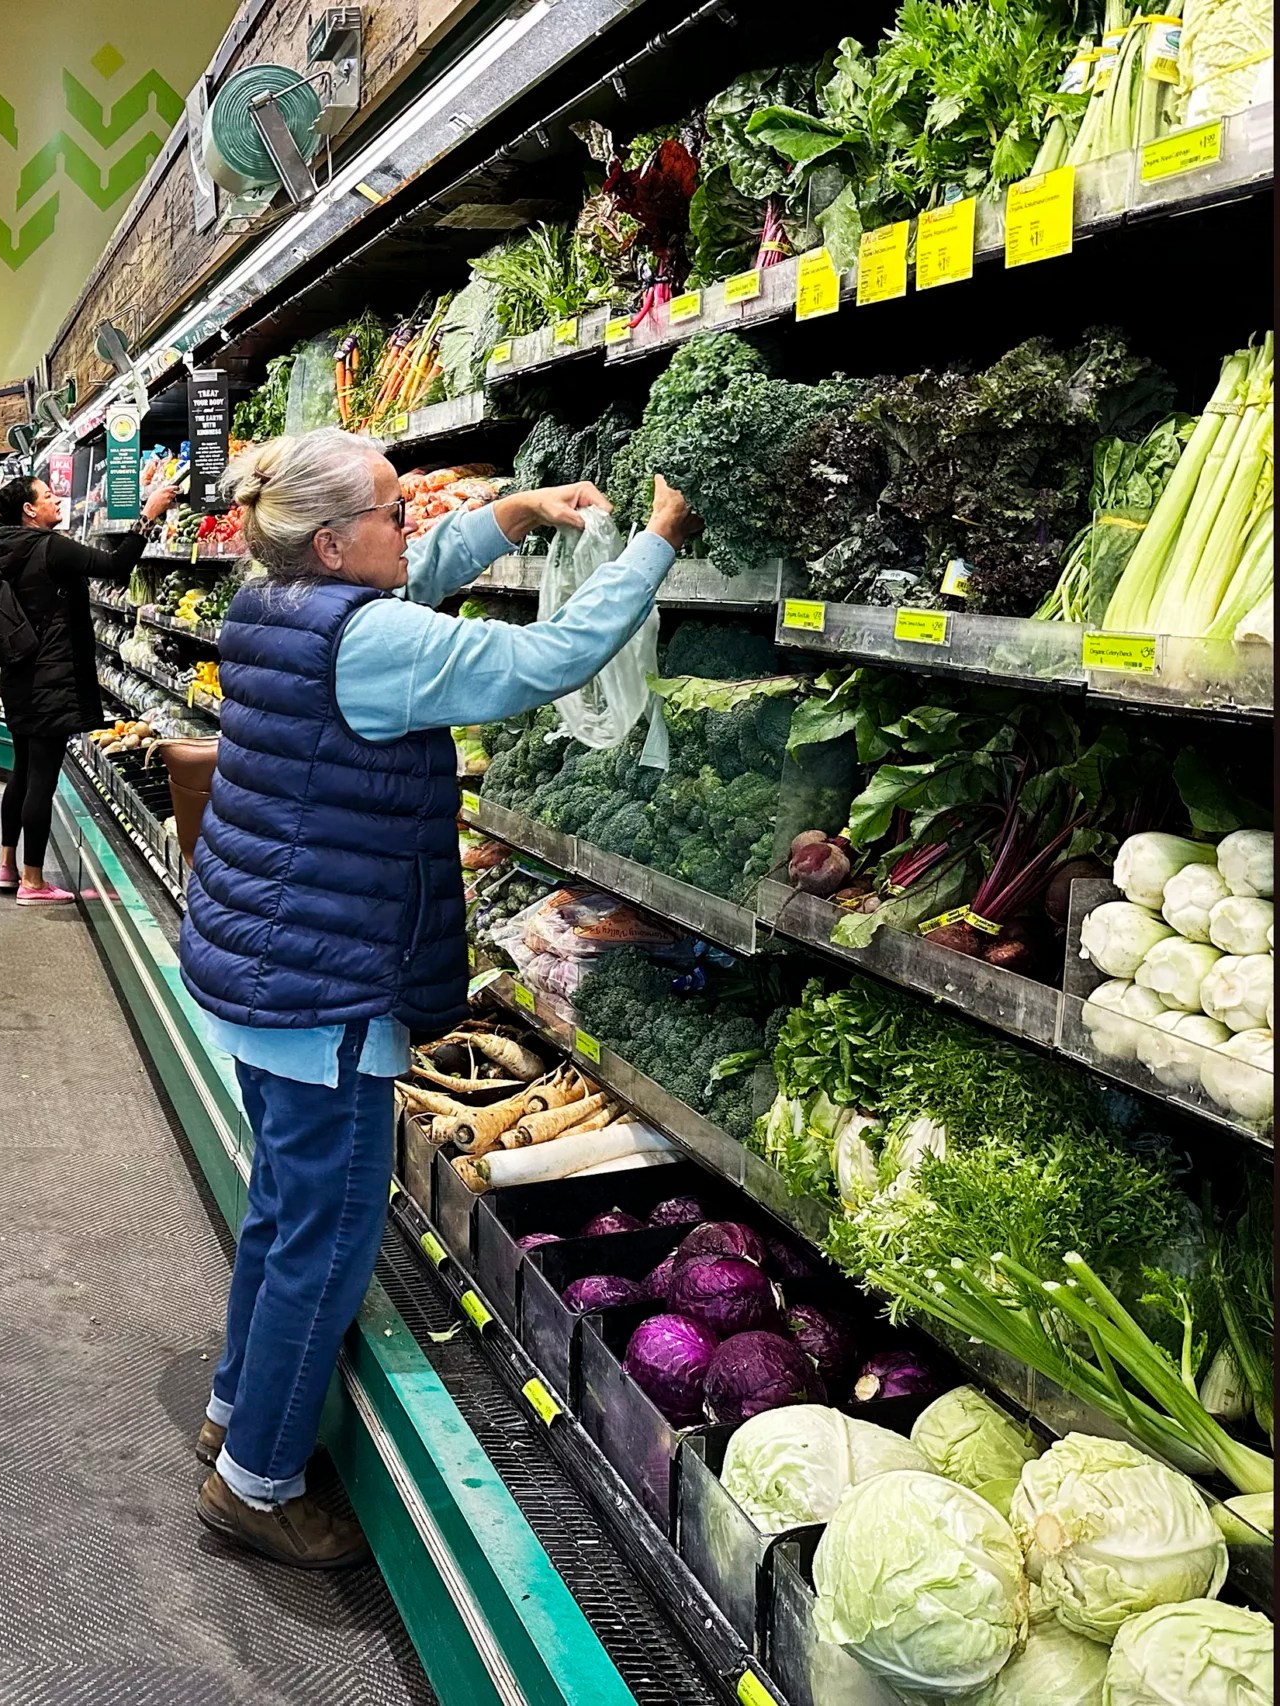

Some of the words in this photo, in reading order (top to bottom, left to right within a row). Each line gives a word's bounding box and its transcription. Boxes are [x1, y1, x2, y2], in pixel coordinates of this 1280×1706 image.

[197, 389, 219, 398] TREAT
[193, 399, 208, 407] YOUR
[52, 460, 71, 468] LOCAL
[602, 926, 627, 938] Valley
